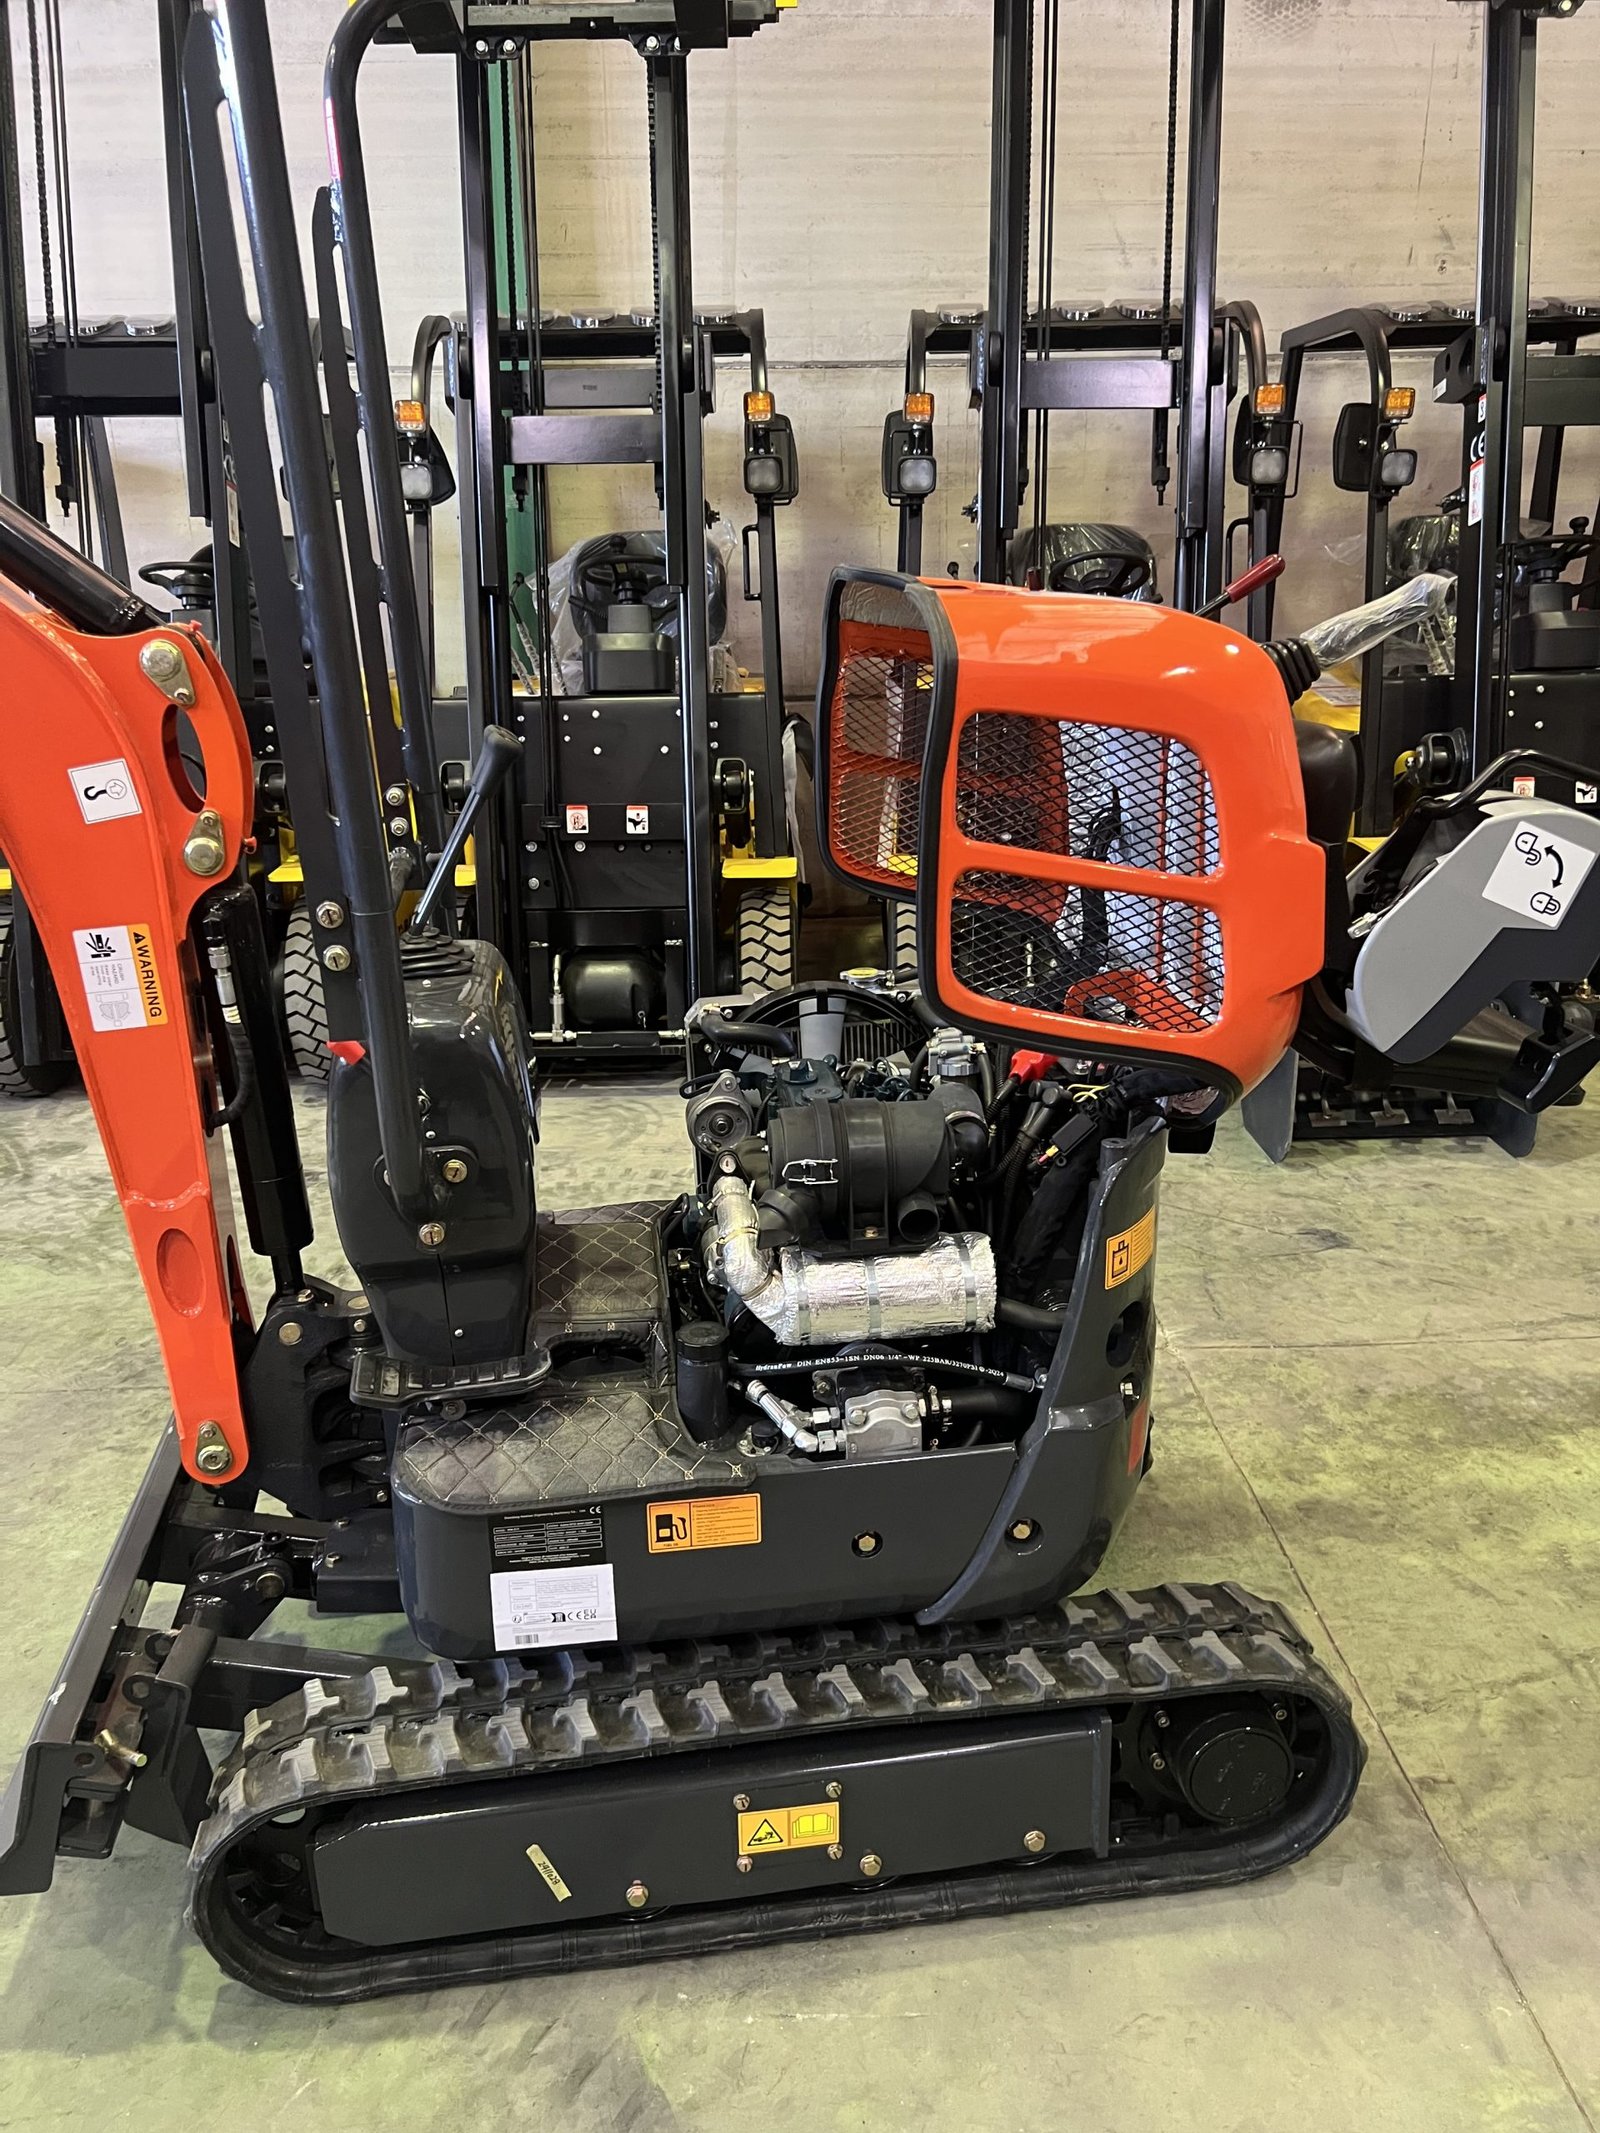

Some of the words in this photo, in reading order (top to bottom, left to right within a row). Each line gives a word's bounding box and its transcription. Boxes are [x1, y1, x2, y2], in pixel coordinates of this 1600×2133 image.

[136, 944, 162, 1017] WARNING
[796, 1360, 812, 1368] DIN
[590, 1505, 601, 1514] CE
